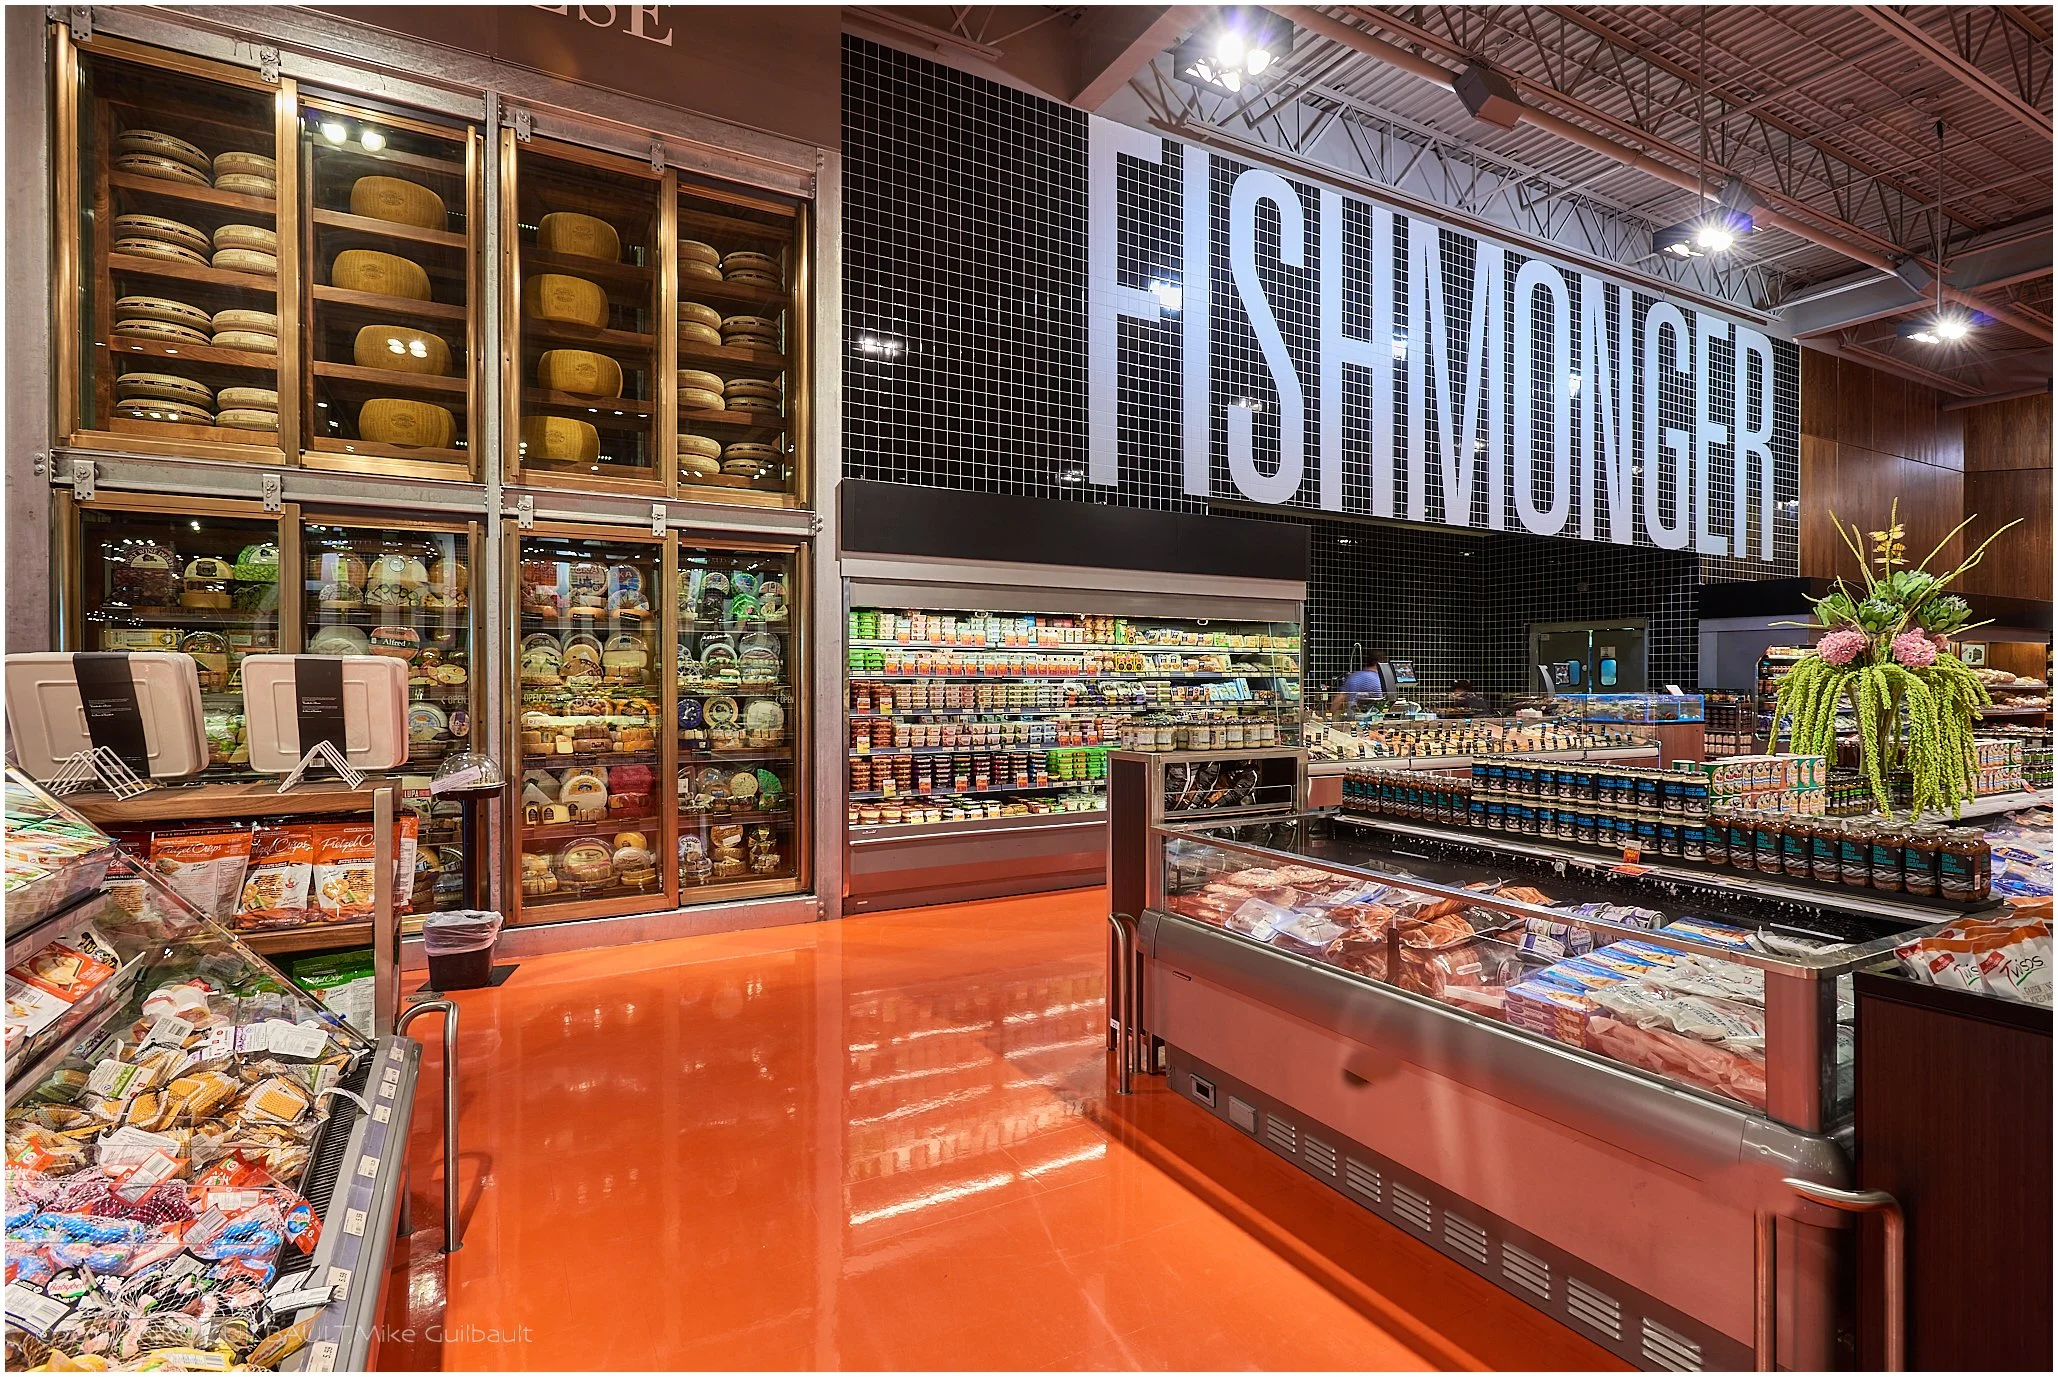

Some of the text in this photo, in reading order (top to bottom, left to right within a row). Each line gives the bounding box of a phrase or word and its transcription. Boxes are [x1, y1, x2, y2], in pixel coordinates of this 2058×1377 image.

[1088, 113, 1776, 562] FISHMONGER
[382, 638, 406, 647] Alfred
[447, 695, 467, 705] OPEN
[780, 695, 795, 704] OPEN
[404, 789, 419, 798] LUPA
[320, 834, 361, 854] Pretzel
